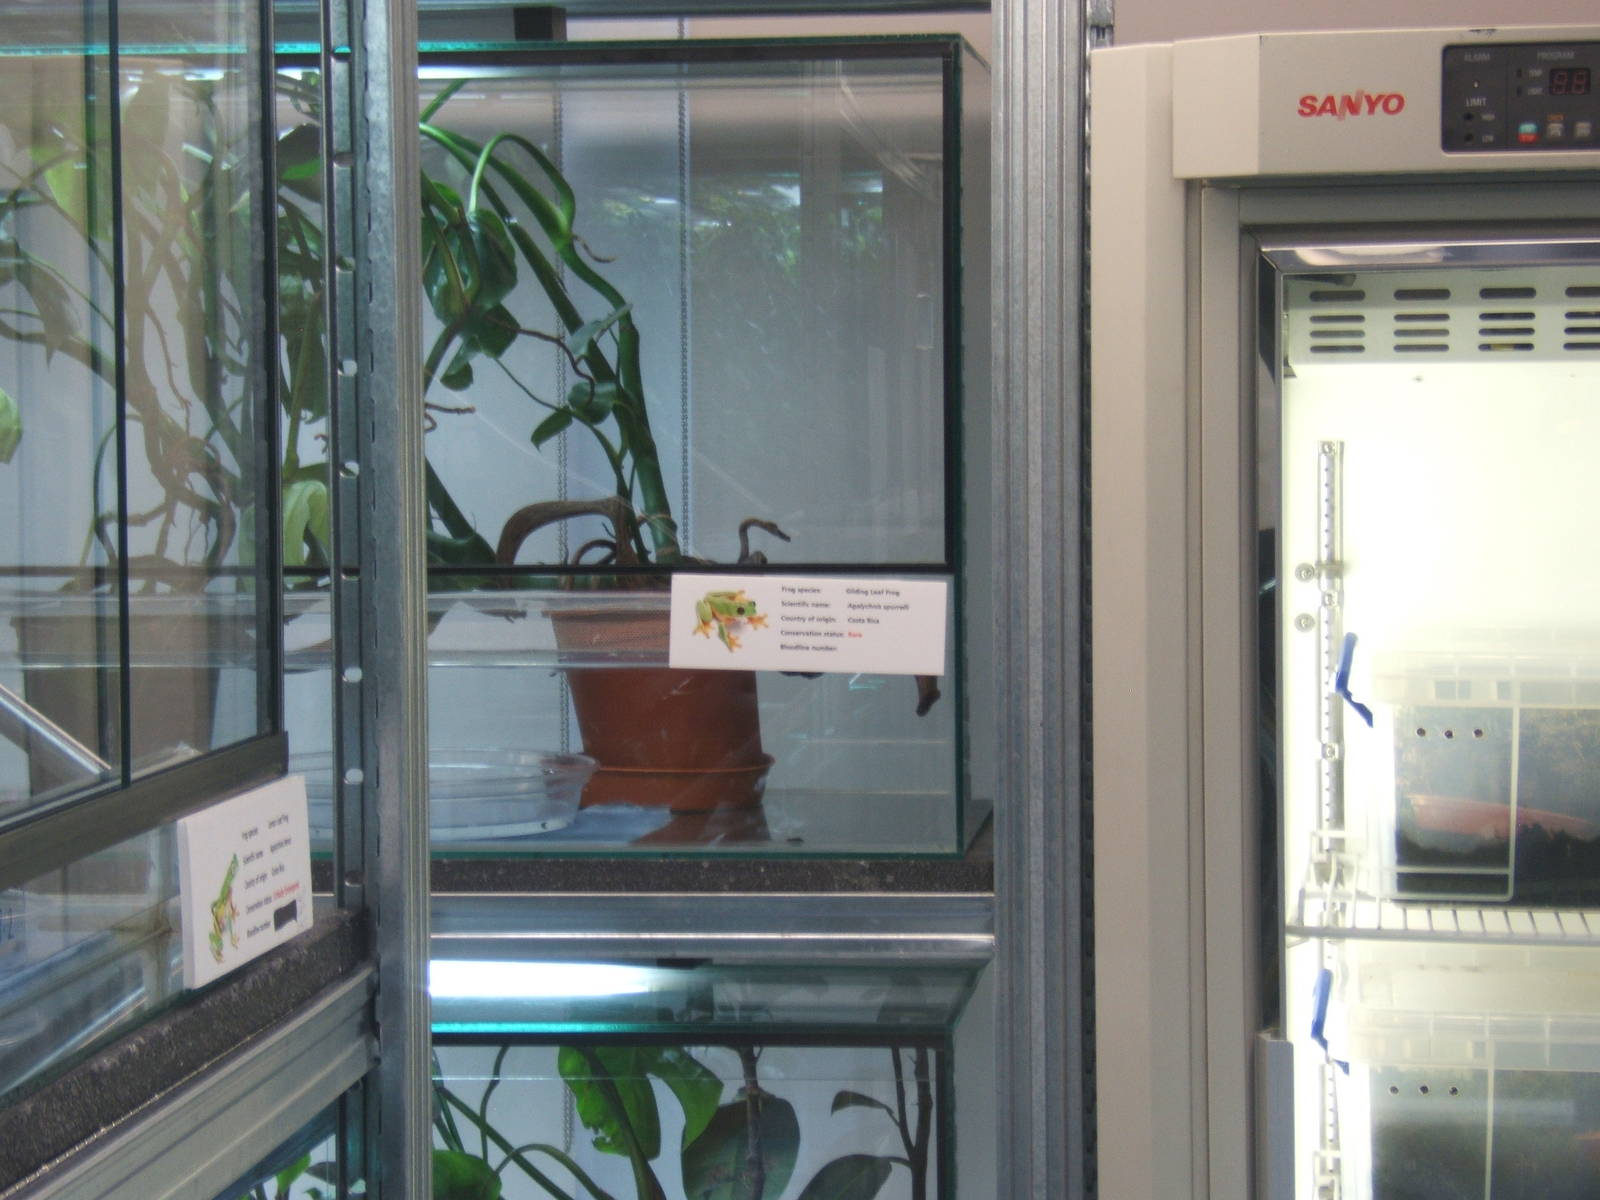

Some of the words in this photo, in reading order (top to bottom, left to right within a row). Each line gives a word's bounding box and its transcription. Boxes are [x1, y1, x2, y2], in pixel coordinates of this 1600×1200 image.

[1297, 90, 1405, 121] SANYO
[1465, 97, 1487, 107] LIMIT
[782, 586, 796, 594] Frog
[846, 588, 869, 596] Gliding
[885, 589, 900, 597] Frog
[780, 615, 806, 623] Country
